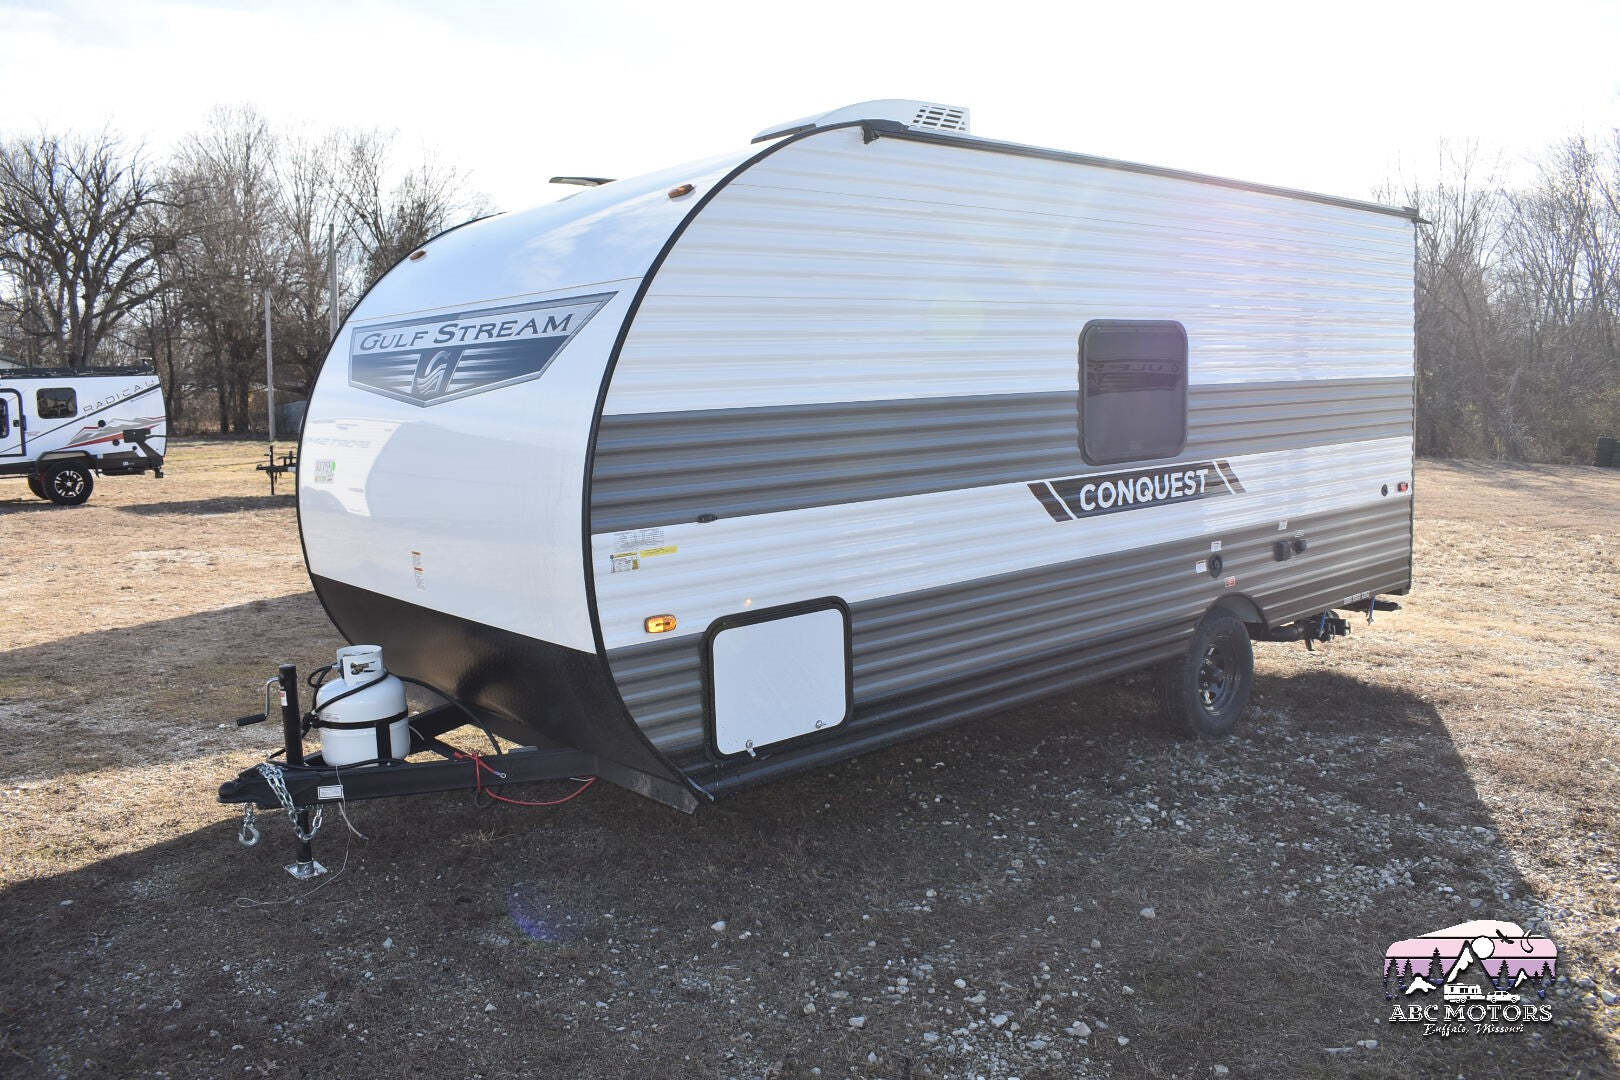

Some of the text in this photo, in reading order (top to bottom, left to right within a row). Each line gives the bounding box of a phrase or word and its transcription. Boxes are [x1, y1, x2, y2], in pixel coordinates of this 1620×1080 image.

[360, 313, 574, 351] GULF STREAM
[82, 379, 155, 414] RADICAL
[1079, 468, 1209, 511] CONQUEST
